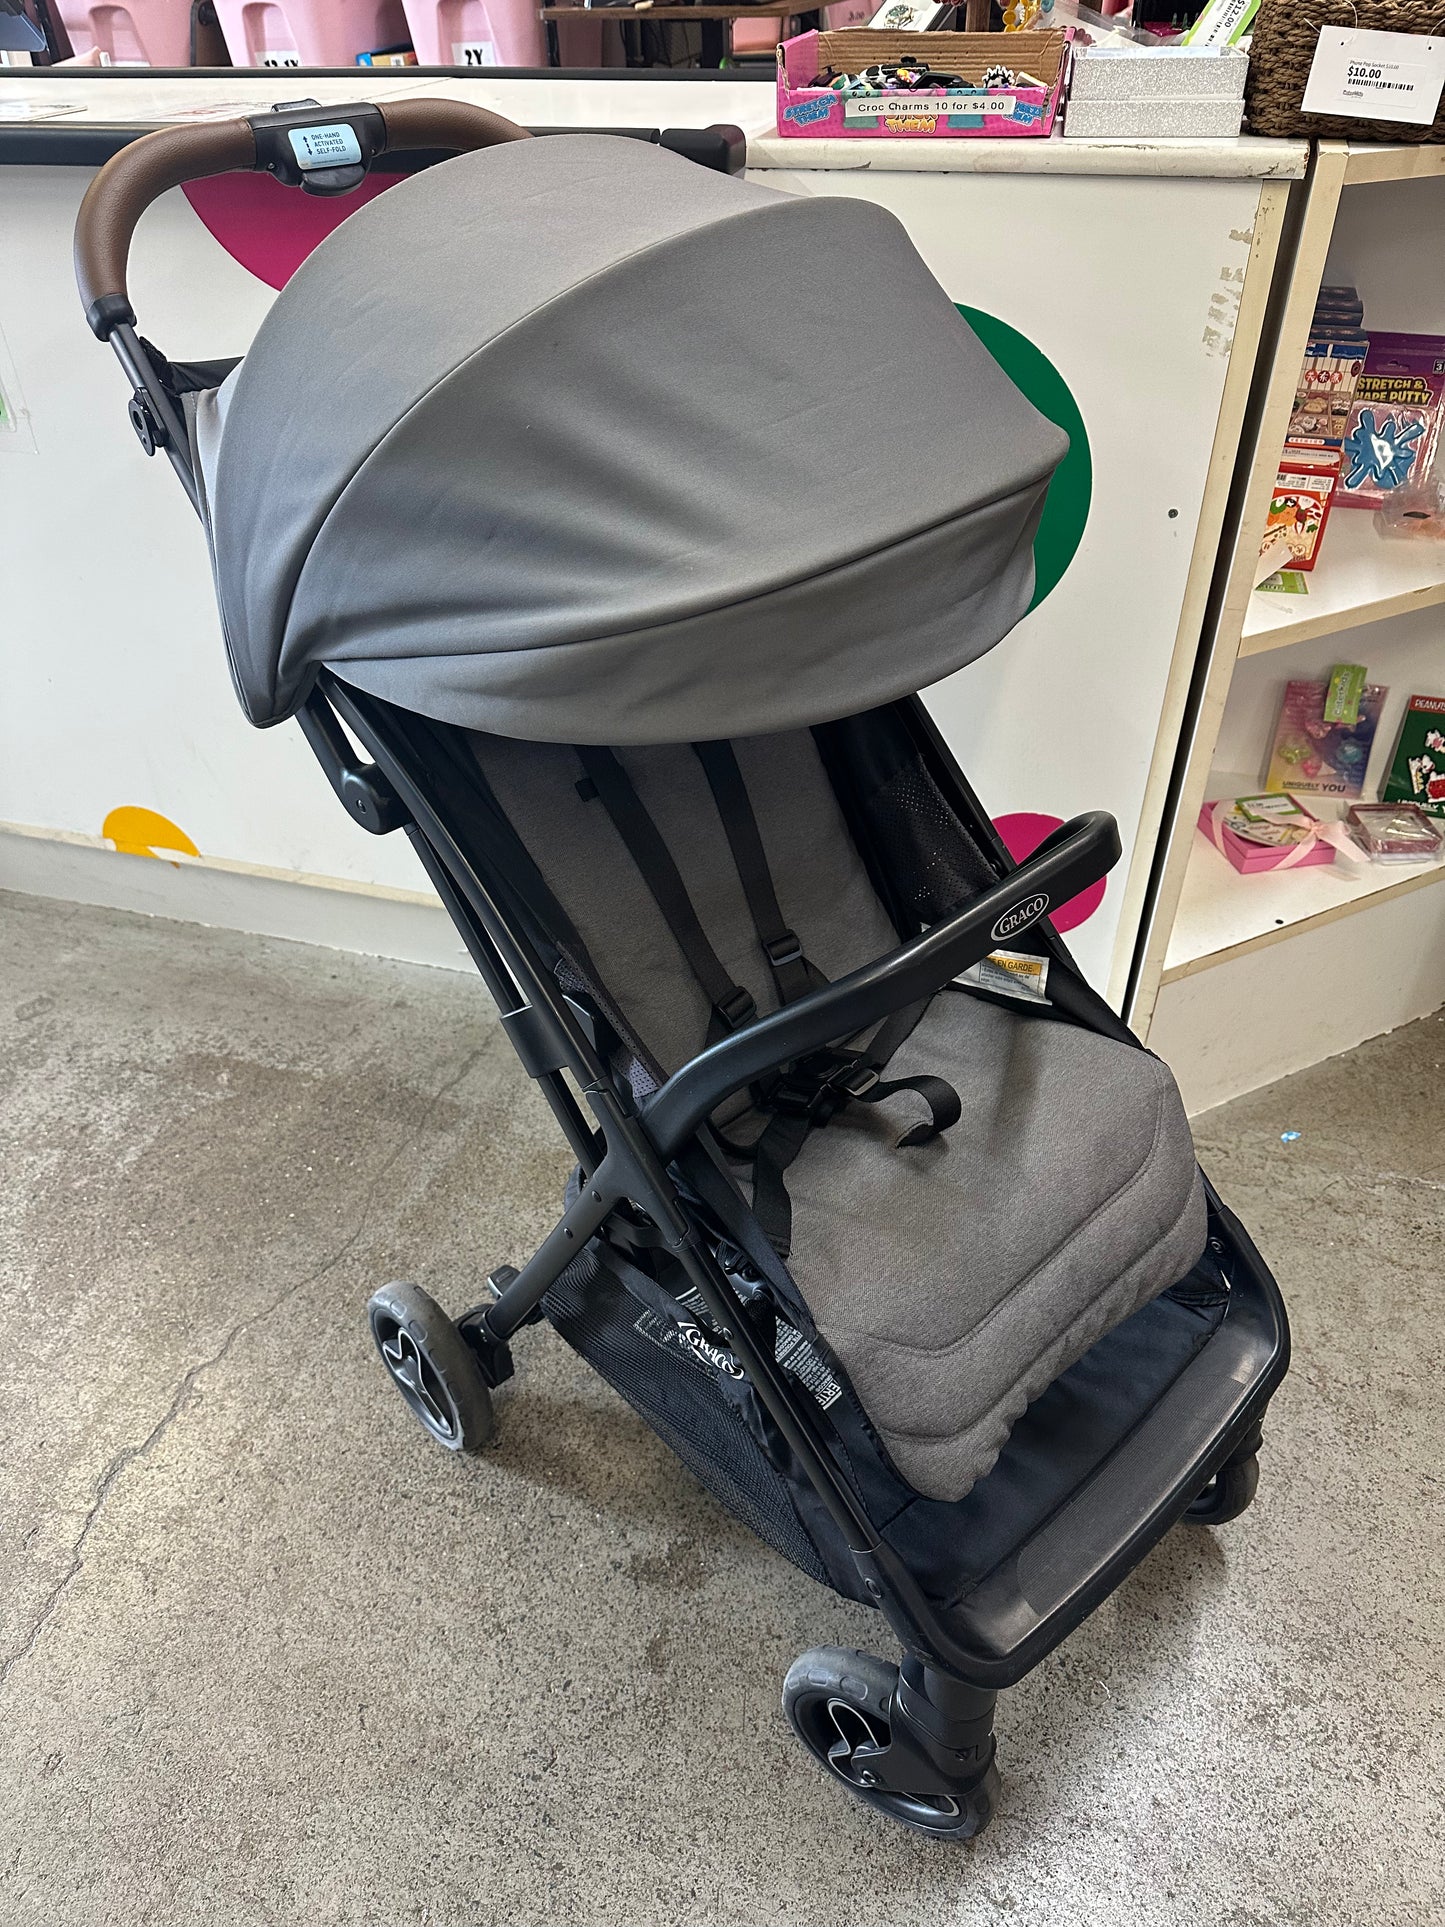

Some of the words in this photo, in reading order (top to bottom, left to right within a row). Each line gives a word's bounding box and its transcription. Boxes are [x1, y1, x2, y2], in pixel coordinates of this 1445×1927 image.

[1347, 66, 1382, 79] $10.00
[784, 94, 838, 119] STRETCH
[858, 103, 884, 112] Croc
[888, 102, 930, 111] Charms
[935, 102, 948, 110] 10
[952, 101, 968, 110] for
[972, 101, 1005, 110] $4.00
[885, 117, 937, 133] THEM
[311, 131, 340, 140] ONE-HAND
[314, 138, 344, 147] ACTIVATED
[316, 145, 346, 155] SELF-FOLD
[1435, 363, 1443, 371] 3
[1358, 377, 1411, 390] STRETCH
[1414, 379, 1424, 390] &
[1356, 390, 1387, 401] HAPE
[1389, 390, 1430, 404] PUTTY
[1322, 783, 1346, 793] YOU
[1000, 897, 1044, 934] GRACO
[997, 959, 1007, 968] EN
[1007, 961, 1034, 973] GARDE
[685, 1328, 735, 1374] GRACO
